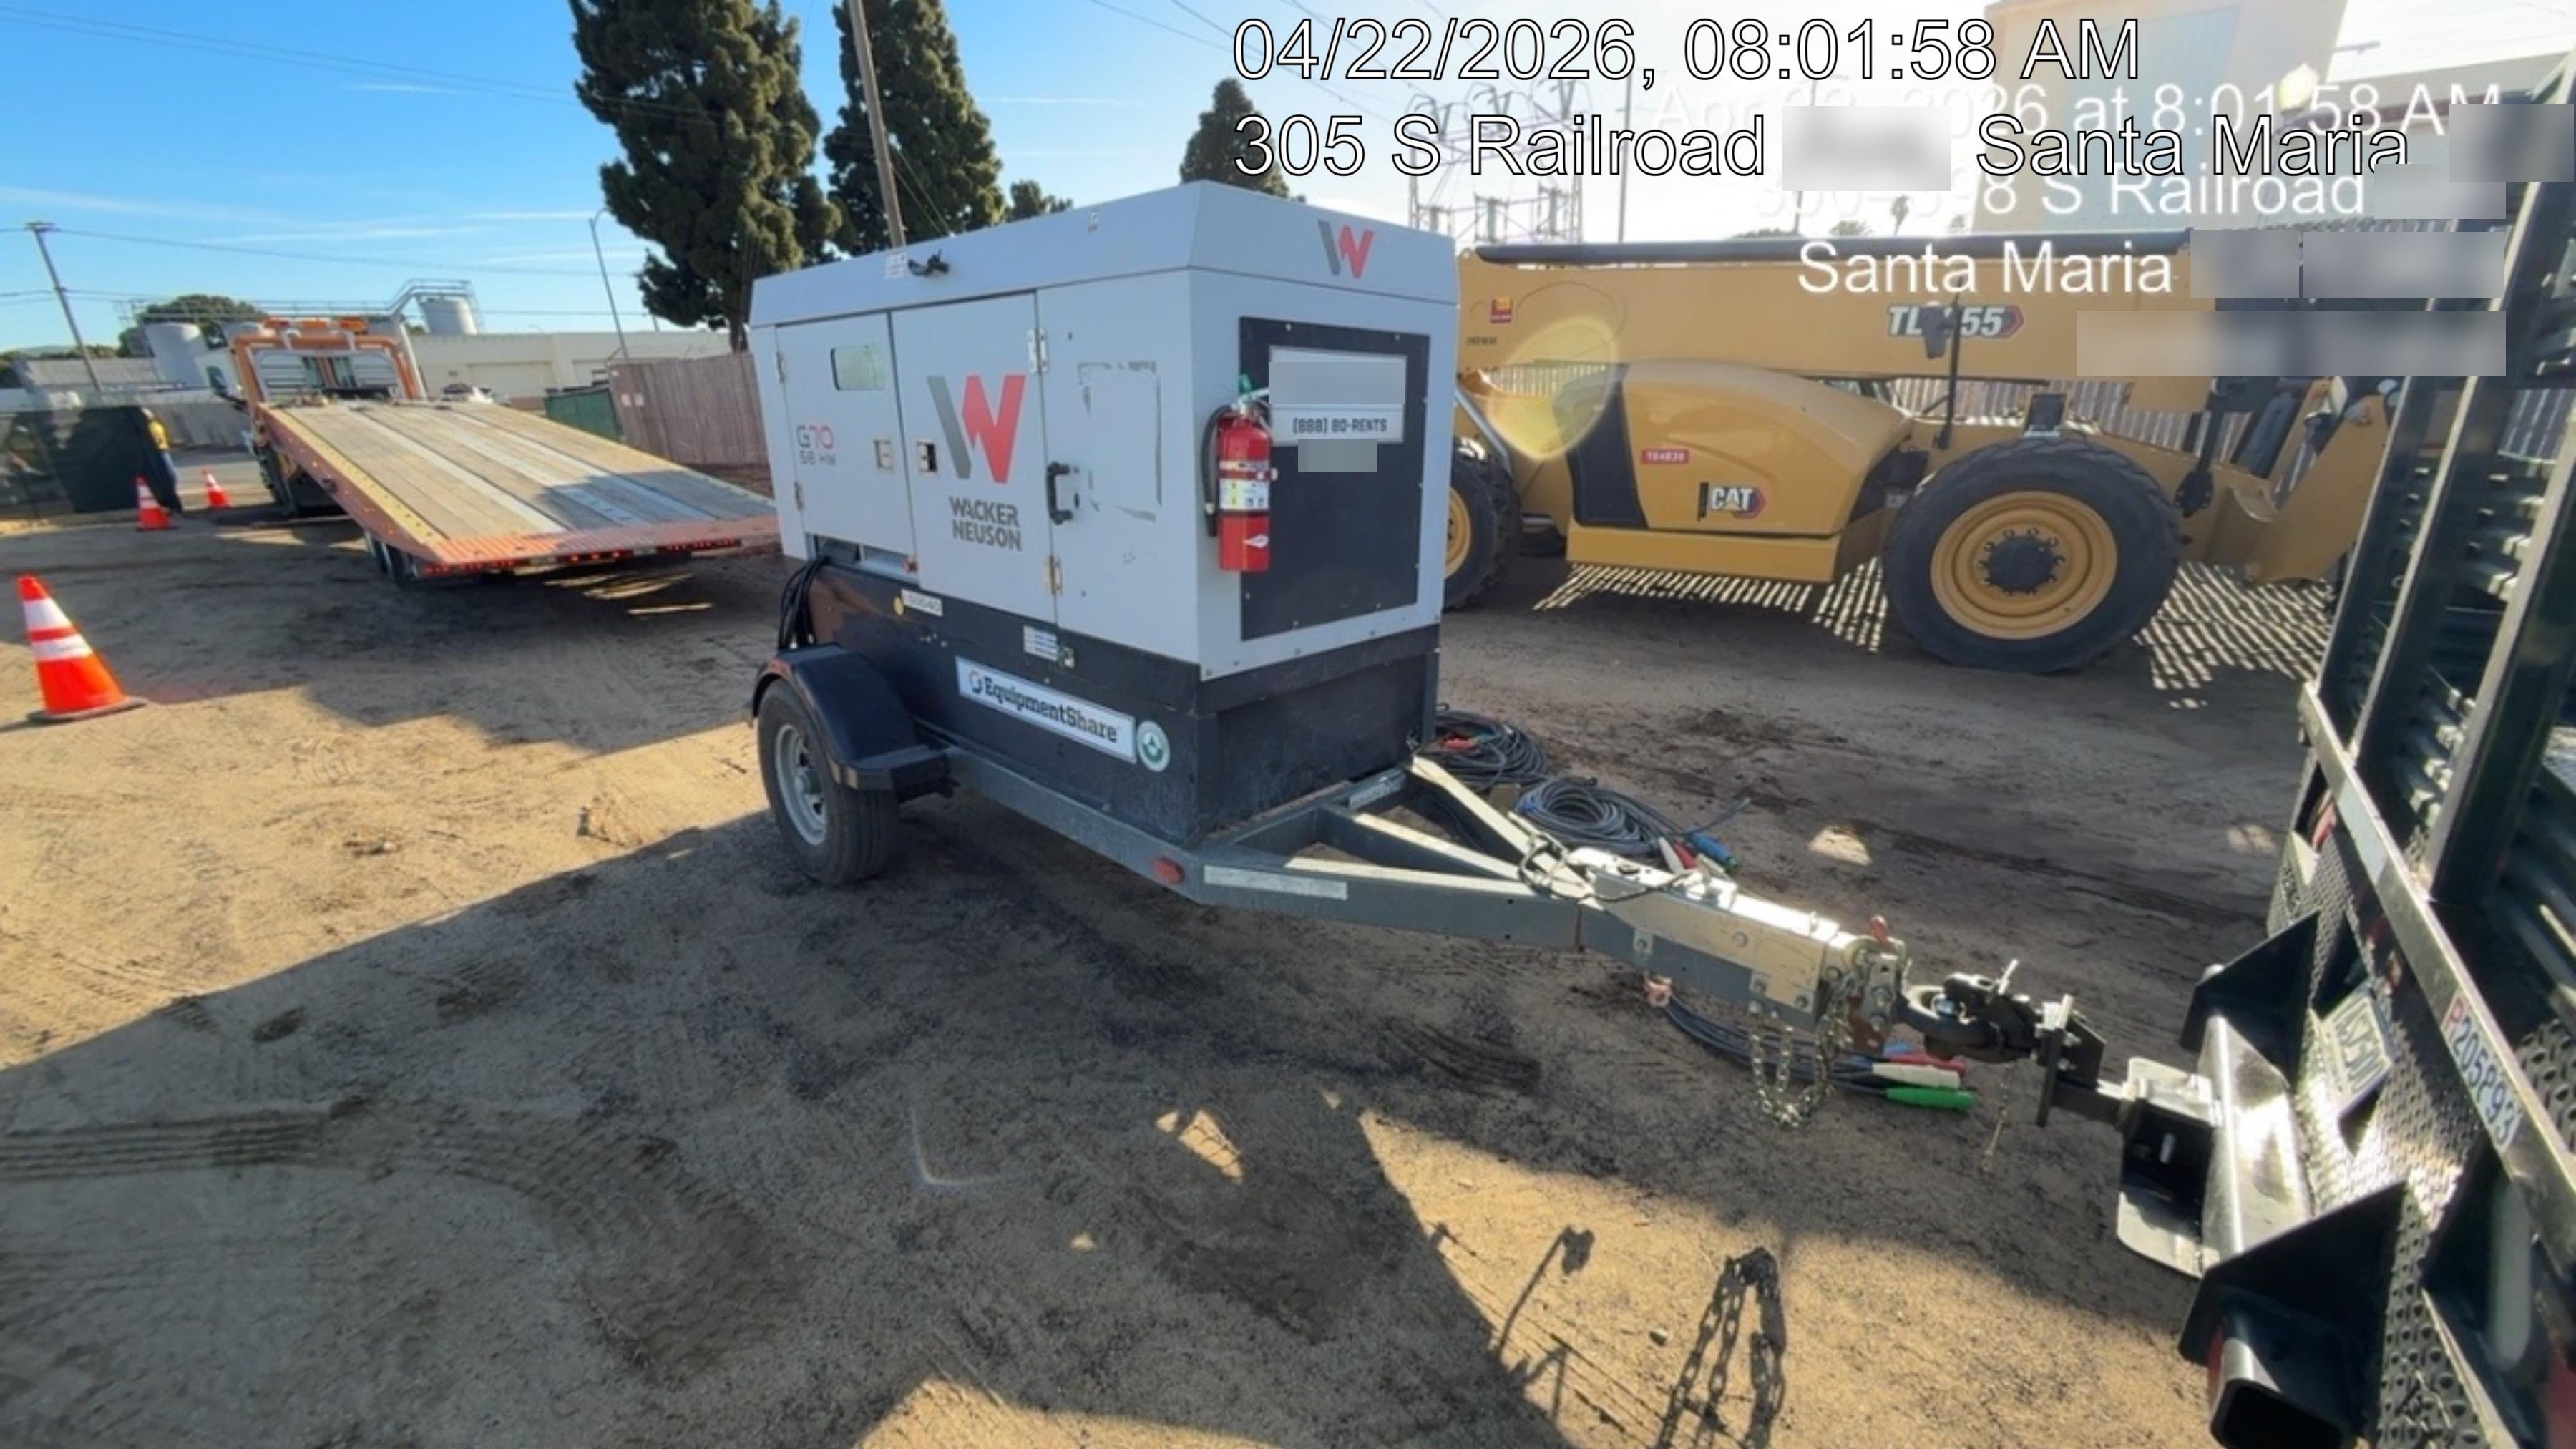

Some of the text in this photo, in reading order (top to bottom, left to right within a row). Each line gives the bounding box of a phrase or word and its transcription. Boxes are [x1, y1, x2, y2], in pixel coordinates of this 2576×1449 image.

[1889, 306, 2005, 336] TL55
[949, 495, 1020, 527] WACKER
[1712, 487, 1754, 512] CAT
[952, 519, 1023, 552] NEUSON
[982, 677, 1117, 744] EquipmentShare
